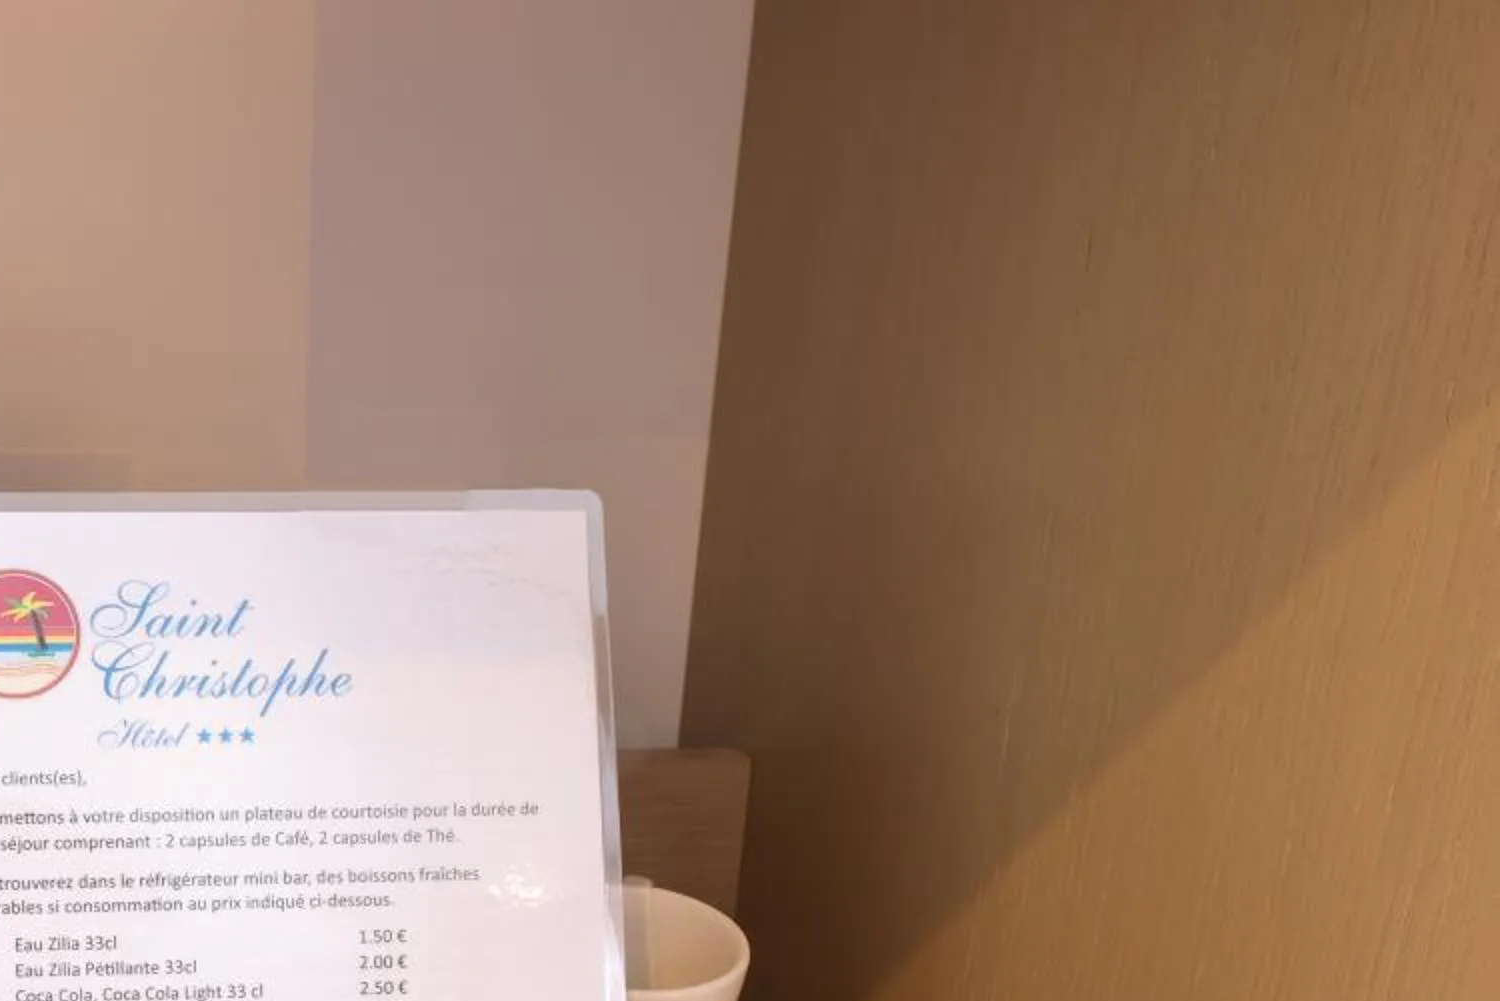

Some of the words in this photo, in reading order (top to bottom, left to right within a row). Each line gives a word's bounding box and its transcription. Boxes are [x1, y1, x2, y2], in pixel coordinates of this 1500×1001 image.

[90, 580, 254, 638] Saint
[92, 640, 353, 717] Christophe
[97, 720, 190, 750] Hôtel
[68, 809, 80, 824] à
[82, 811, 125, 825] votre
[128, 806, 216, 825] disposition
[219, 809, 240, 821] un
[244, 805, 304, 824] plateau
[307, 805, 328, 820] de
[331, 804, 409, 820] courtoisie
[412, 806, 448, 821] pour
[453, 801, 467, 818] la
[471, 802, 516, 817] durée
[519, 802, 539, 815] de
[0, 835, 50, 854] séjour
[53, 836, 151, 853] comprenant
[165, 833, 175, 848] 2
[179, 832, 247, 852] capsules
[250, 832, 271, 847] de
[274, 830, 314, 848] Café,
[319, 830, 328, 845] 2
[332, 829, 399, 848] capsules
[402, 829, 422, 843] de
[77, 875, 117, 890] dans
[119, 874, 135, 888] le
[138, 871, 239, 891] réfrigérateur
[243, 871, 279, 886] mini
[282, 869, 311, 887] bar,
[316, 870, 344, 885] des
[347, 867, 415, 885] boissons
[418, 865, 480, 881] fraîches
[47, 900, 60, 914] si
[63, 897, 183, 914] consommation
[187, 898, 207, 911] au
[211, 897, 241, 913] prix
[245, 894, 305, 913] indiqué
[14, 937, 44, 953] Eau
[47, 936, 81, 952] Zilia
[85, 935, 118, 951] 33cl
[359, 928, 394, 944] 1.50
[396, 929, 407, 943] €
[14, 963, 44, 978] Eau
[48, 962, 81, 977] Zilia
[84, 961, 160, 977] Pétillante
[165, 959, 197, 975] 33cl
[359, 954, 394, 970] 2.00
[397, 954, 407, 969] €
[101, 986, 142, 1001] Coca
[144, 986, 180, 1001] Cola
[227, 982, 247, 999] 33
[250, 983, 264, 999] cl
[359, 981, 395, 996] 2.50
[397, 980, 408, 994] €
